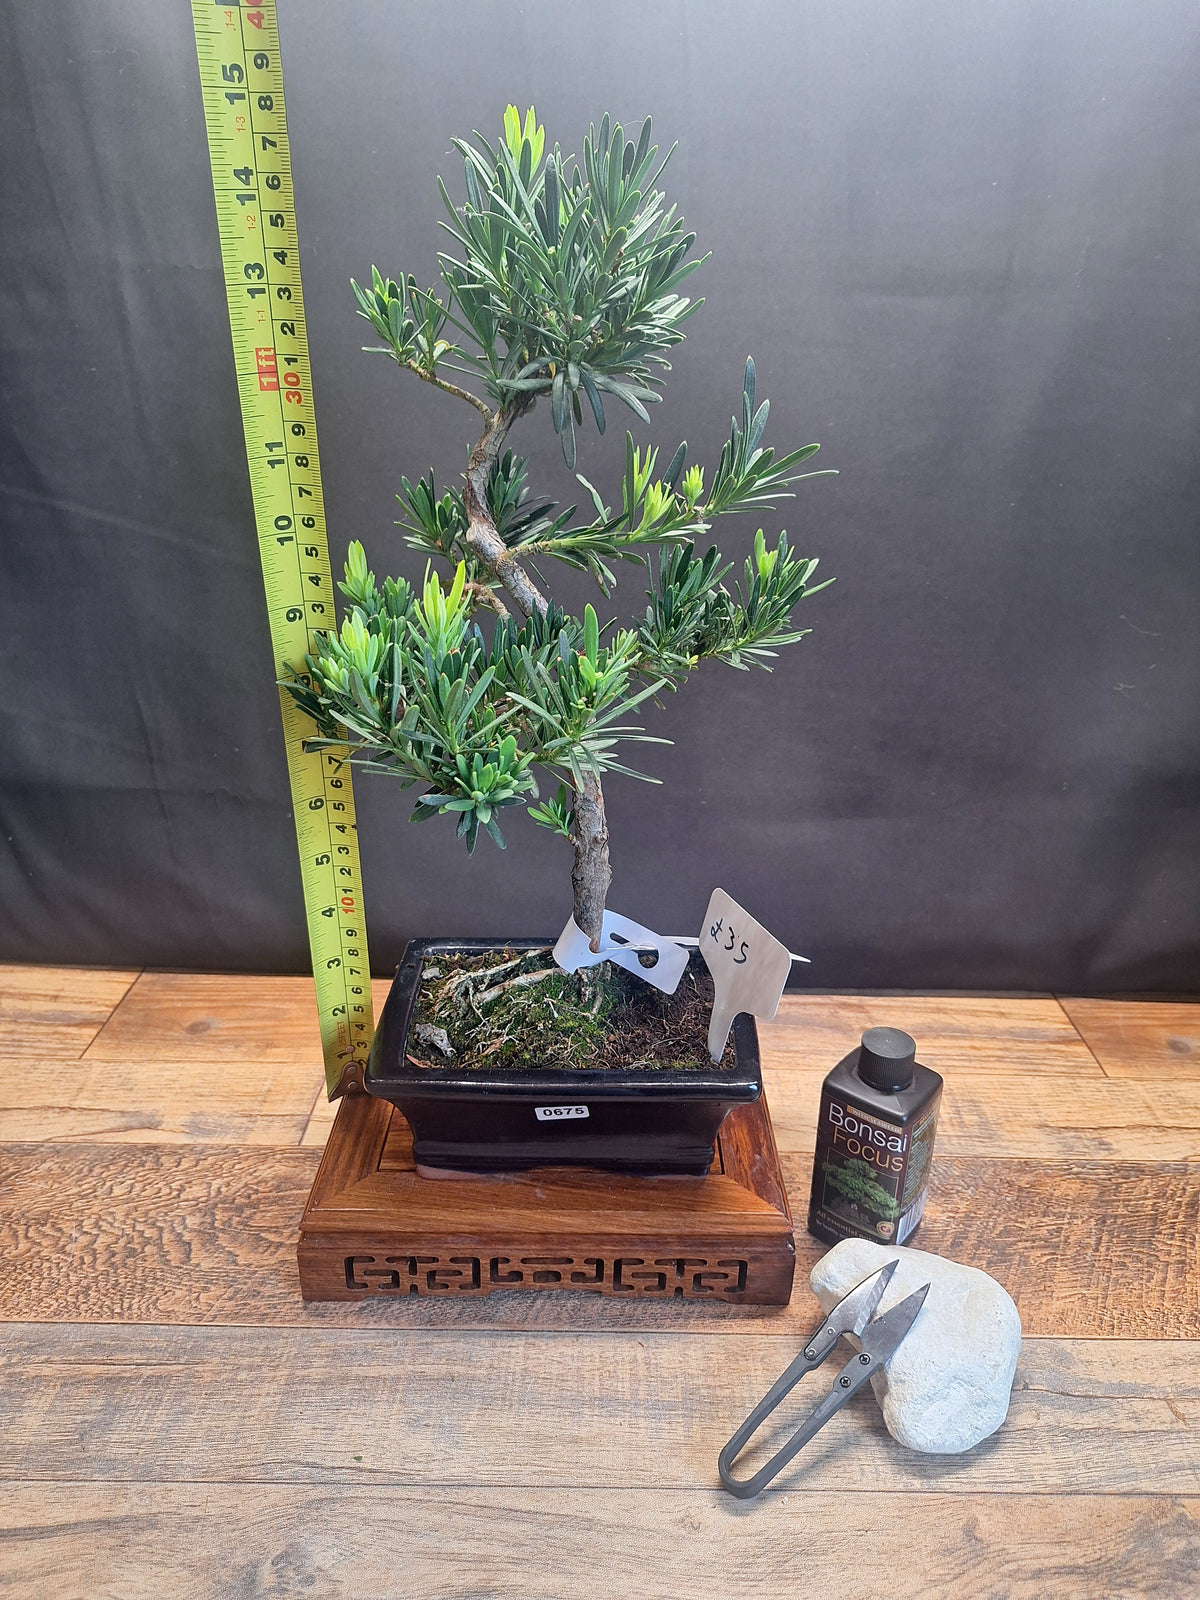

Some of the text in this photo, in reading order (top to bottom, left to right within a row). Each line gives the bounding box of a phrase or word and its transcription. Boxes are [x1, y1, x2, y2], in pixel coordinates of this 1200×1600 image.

[246, 0, 265, 29] 4
[253, 53, 269, 70] 9
[221, 63, 246, 105] 15
[257, 94, 274, 111] 8
[261, 136, 278, 151] 7
[233, 166, 256, 206] 14
[265, 174, 281, 190] 6
[269, 213, 285, 229] 5
[273, 250, 288, 266] 4
[244, 262, 266, 299] 13
[277, 286, 292, 301] 3
[280, 322, 296, 336] 2
[284, 357, 298, 366] 1
[284, 372, 302, 405] 30
[291, 423, 306, 437] 9
[265, 441, 285, 469] 11
[295, 455, 309, 468] 8
[298, 486, 313, 498] 7
[301, 516, 316, 529] 6
[274, 515, 294, 546] 10
[305, 546, 319, 558] 5
[308, 575, 322, 587] 4
[286, 608, 303, 622] 9
[311, 603, 325, 614] 3
[330, 779, 343, 789] 6
[309, 797, 325, 811] 6
[333, 802, 346, 812] 5
[335, 824, 347, 834] 4
[337, 846, 350, 855] 3
[315, 854, 330, 866] 5
[340, 867, 352, 876] 2
[341, 896, 355, 914] 10
[321, 907, 336, 918] 4
[346, 928, 358, 938] 9
[348, 948, 360, 957] 8
[327, 957, 342, 969] 3
[350, 967, 362, 977] 7
[351, 986, 363, 995] 6
[332, 1004, 346, 1017] 2
[353, 1005, 364, 1013] 5
[355, 1023, 366, 1031] 4
[356, 1041, 367, 1049] 3
[543, 1106, 585, 1117] 0675
[828, 1102, 908, 1153] Bonsai
[833, 1125, 904, 1172] Focus
